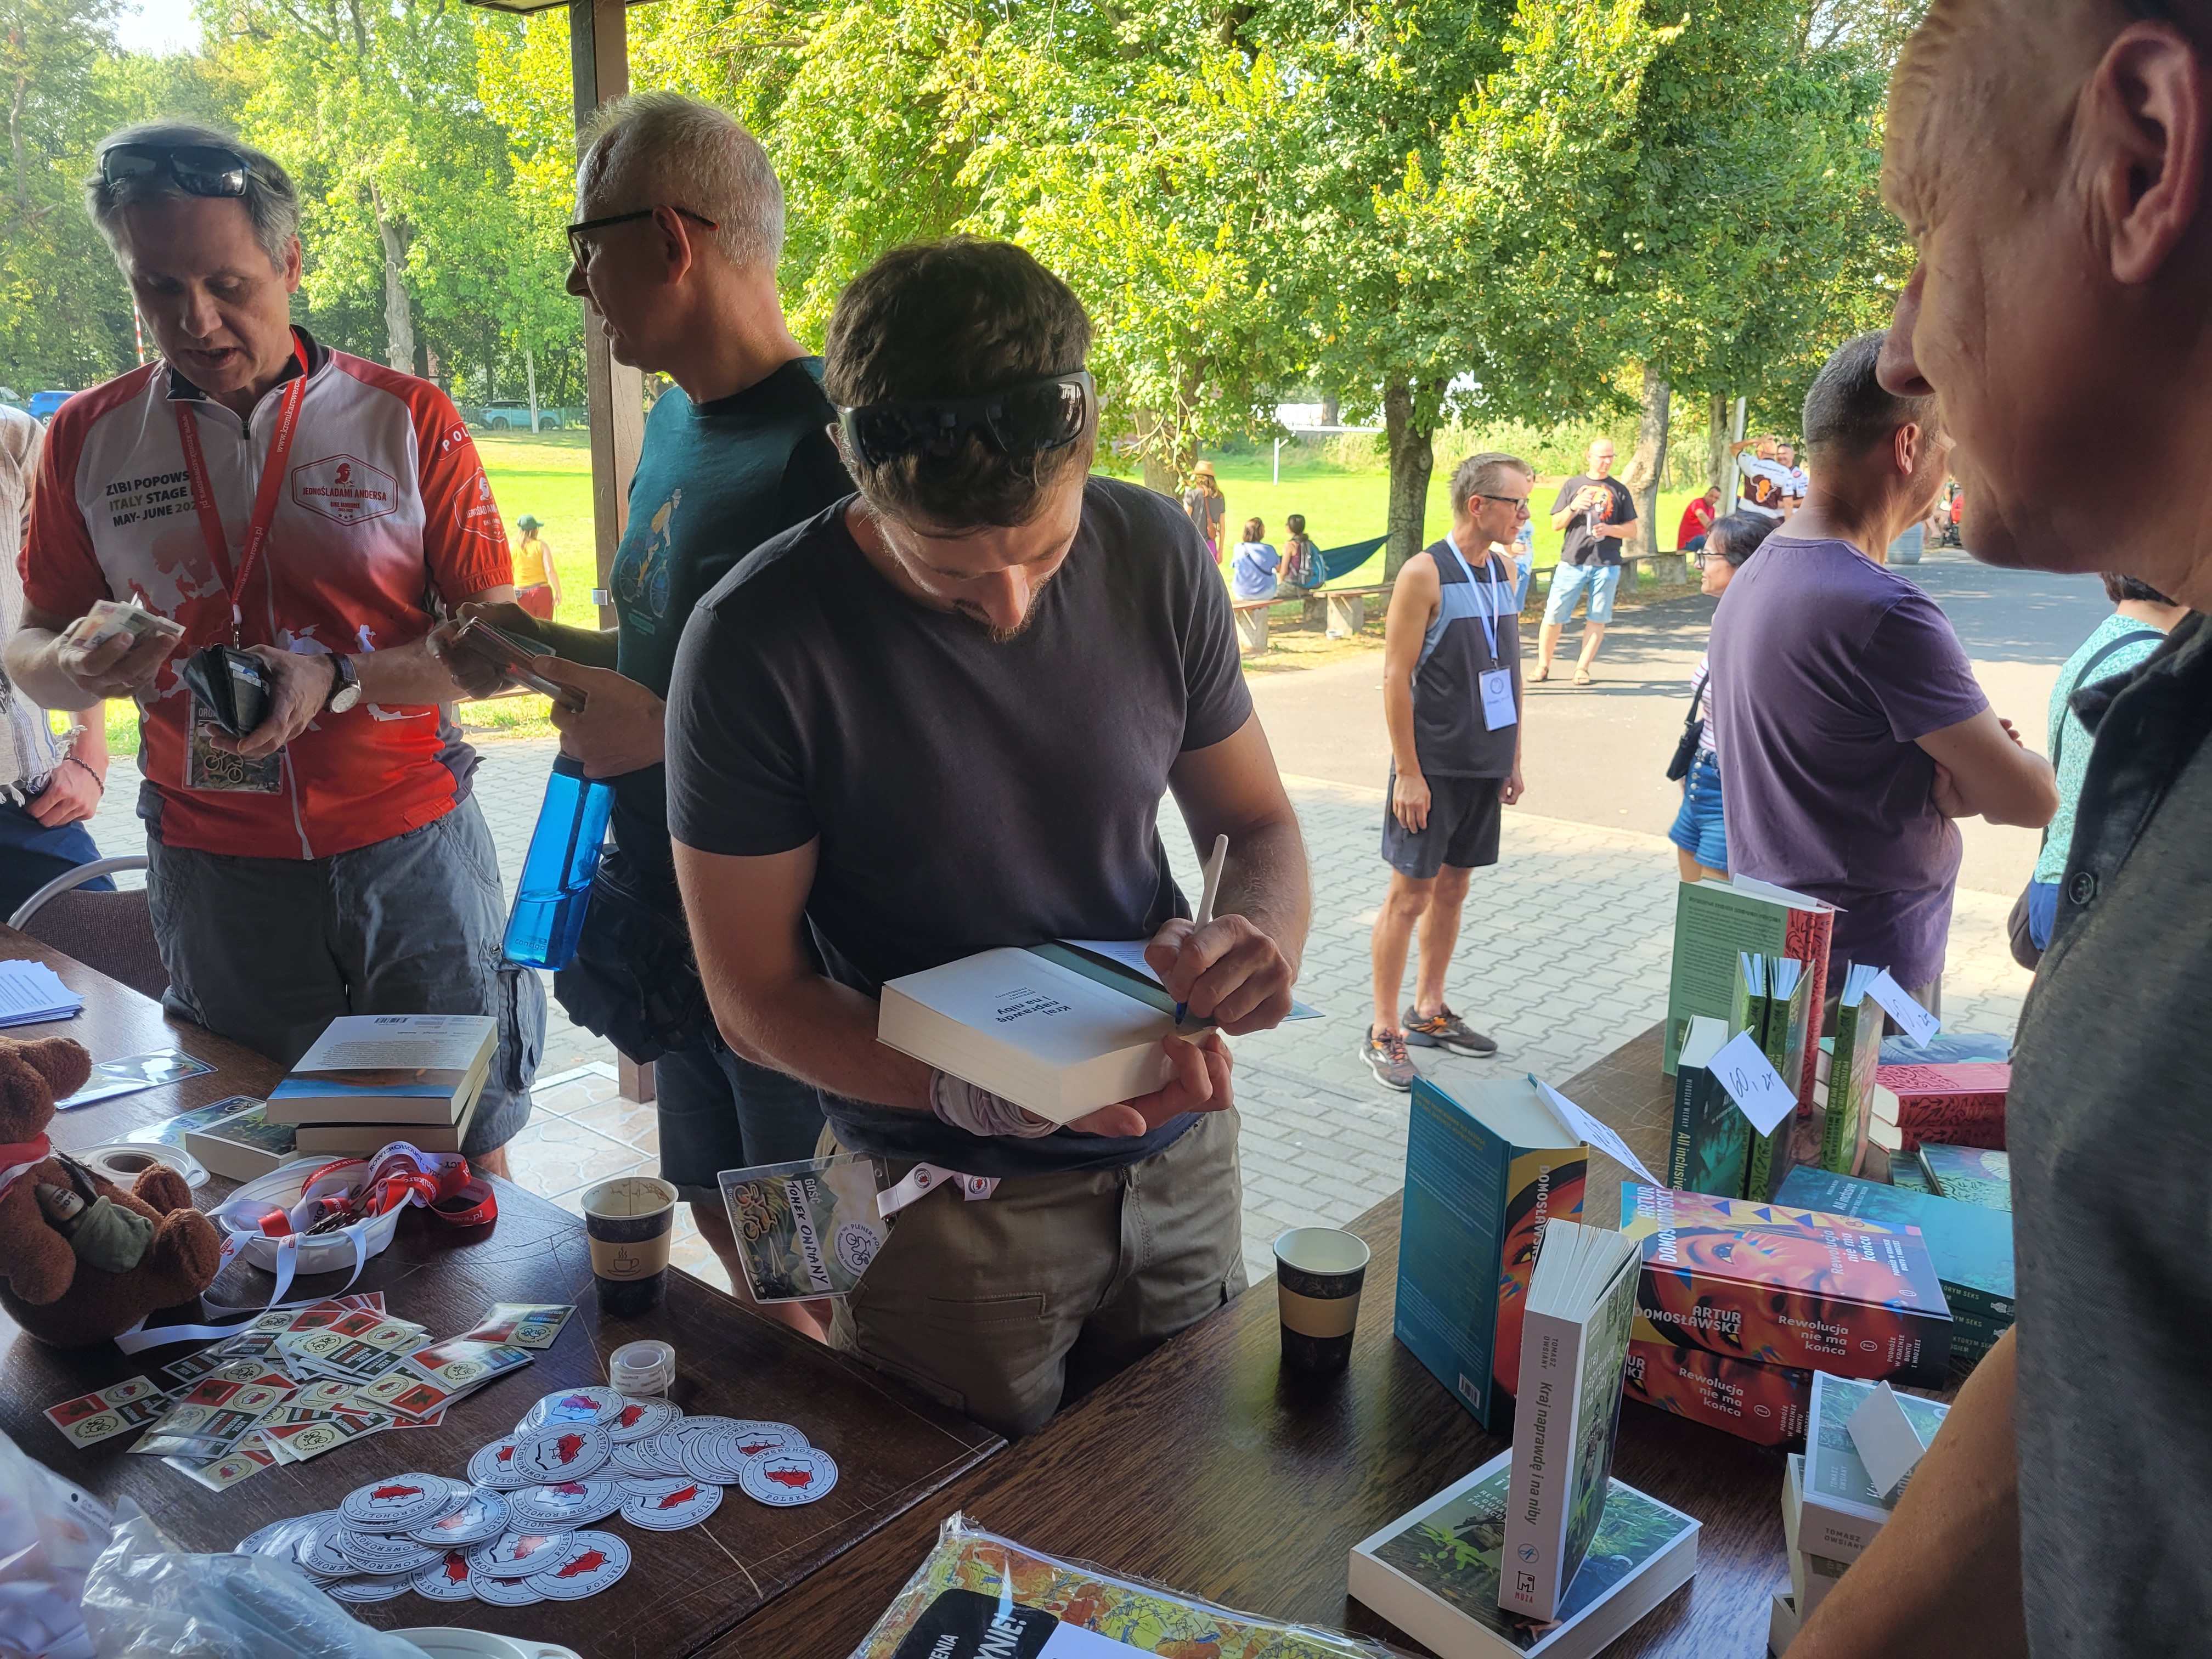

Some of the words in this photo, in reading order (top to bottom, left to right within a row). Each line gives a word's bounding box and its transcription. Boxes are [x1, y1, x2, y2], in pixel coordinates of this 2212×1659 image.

[182, 414, 211, 509] www.kronikarowerowa.pl
[106, 481, 132, 496] ZIBI
[303, 486, 352, 498] JEDNOŚLADAMI
[354, 488, 387, 501] ANDERSA
[109, 494, 143, 513] ITALY
[146, 486, 187, 505] STAGE
[143, 504, 173, 521] JUNE
[515, 937, 546, 951] contigo
[995, 1000, 1060, 1023] naprawdę
[997, 1003, 1025, 1015] niby
[1042, 1005, 1072, 1017] Kraj
[1677, 1131, 1691, 1146] All
[369, 1143, 424, 1172] ROWEROHOLICY
[1672, 1147, 1689, 1191] inclusive
[804, 1178, 823, 1204] GOŚĆ
[1637, 1186, 1656, 1219] ARTUR
[850, 1223, 873, 1237] PLENER
[1841, 1233, 1855, 1247] ma
[837, 1232, 845, 1260] Kazimierza
[1821, 1230, 1844, 1275] Rewolucja
[1843, 1248, 1859, 1262] nie
[1858, 1235, 1877, 1262] końca
[1963, 1291, 1980, 1300] SEKS
[1634, 1306, 1741, 1334] DOMOSŁAWSKI
[1692, 1305, 1741, 1324] ARTUR
[1778, 1315, 1849, 1335] Rewolucja
[1966, 1318, 1982, 1327] SEKS
[1801, 1331, 1822, 1341] nie
[1826, 1335, 1847, 1346] ma
[1805, 1341, 1846, 1356] końca
[1895, 1334, 1905, 1361] KRAINIE
[331, 1342, 359, 1361] BORUSZYN
[356, 1352, 373, 1364] 2024
[1540, 1335, 1550, 1370] OWSIANY
[1585, 1345, 1600, 1374] Kraj
[1887, 1336, 1897, 1363] PODRÓŻE
[1904, 1342, 1912, 1362] BUNTU
[375, 1359, 392, 1370] 2024
[1679, 1367, 1744, 1397] Rewolucja
[1536, 1382, 1553, 1409] Kraj
[1699, 1387, 1719, 1400] nie
[1722, 1394, 1742, 1408] ma
[1703, 1396, 1742, 1418] końca
[231, 1420, 247, 1434] 2024
[723, 1423, 799, 1441] ROWEROHOLICY
[1795, 1413, 1804, 1434] BUNTU
[593, 1429, 607, 1455] POLSKA
[1529, 1408, 1548, 1471] naprawdę
[516, 1432, 549, 1480] ROWEROHOLICY
[752, 1447, 830, 1464] ROWEROHOLICY
[765, 1493, 811, 1502] POLSKA
[1530, 1482, 1541, 1496] na
[349, 1497, 438, 1519] ROWEROHOLICY
[473, 1487, 507, 1534] ROWEROHOLICY
[515, 1497, 592, 1519] ROWEROHOLICY
[691, 1489, 718, 1517] POLSKA
[1481, 1498, 1507, 1515] GUJA
[1524, 1498, 1542, 1526] niby
[1824, 1534, 1866, 1551] OWSIANY
[1825, 1527, 1861, 1542] TOMASZ
[414, 1572, 445, 1596] POLSKA
[585, 1564, 624, 1592] POLSKA
[1515, 1591, 1534, 1604] MUZA
